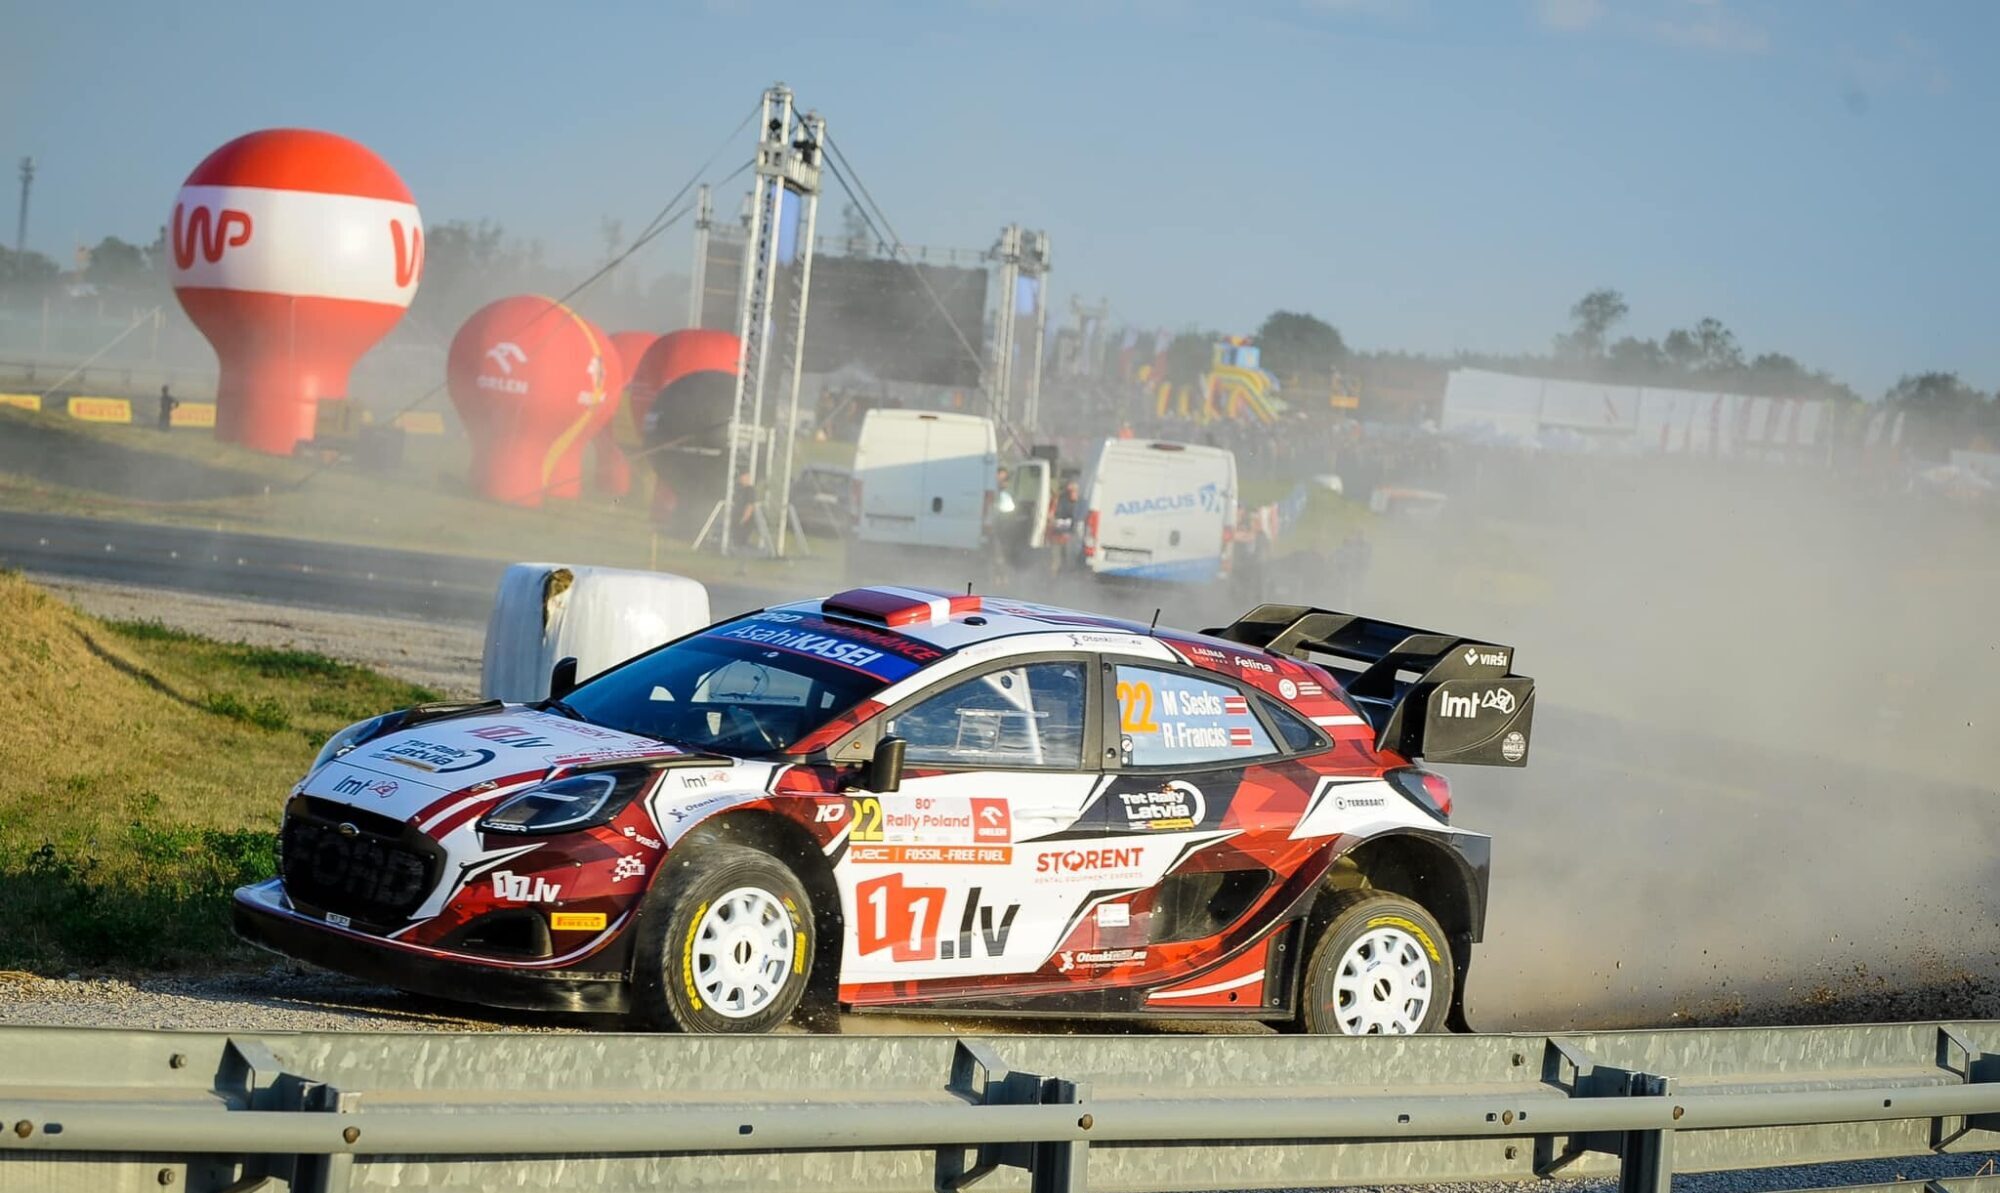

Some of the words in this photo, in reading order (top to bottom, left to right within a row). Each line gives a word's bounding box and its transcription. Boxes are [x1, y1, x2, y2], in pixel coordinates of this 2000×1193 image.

[173, 203, 252, 269] WP
[477, 376, 529, 394] ORLEN
[1113, 494, 1195, 517] ABACUS
[1234, 656, 1274, 673] felina
[1480, 651, 1508, 667] VIRŠI
[1116, 680, 1159, 734] 22
[1161, 690, 1178, 717] M
[1179, 689, 1223, 716] Sesks
[1440, 690, 1480, 718] lmt
[1162, 722, 1176, 748] R
[1178, 721, 1228, 748] Francis
[382, 745, 454, 766] Latvia
[1119, 793, 1149, 805] Tet
[1148, 789, 1186, 805] Rally
[849, 798, 884, 841] 22
[886, 814, 920, 831] Rally
[922, 815, 970, 828] Poland
[1126, 803, 1191, 820] Latvia
[904, 849, 976, 861] FOSSIL-FREE
[977, 850, 1006, 862] FUEL
[1036, 847, 1145, 874] STORENT
[491, 870, 562, 903] 11.lv
[860, 880, 1022, 960] 11.lv
